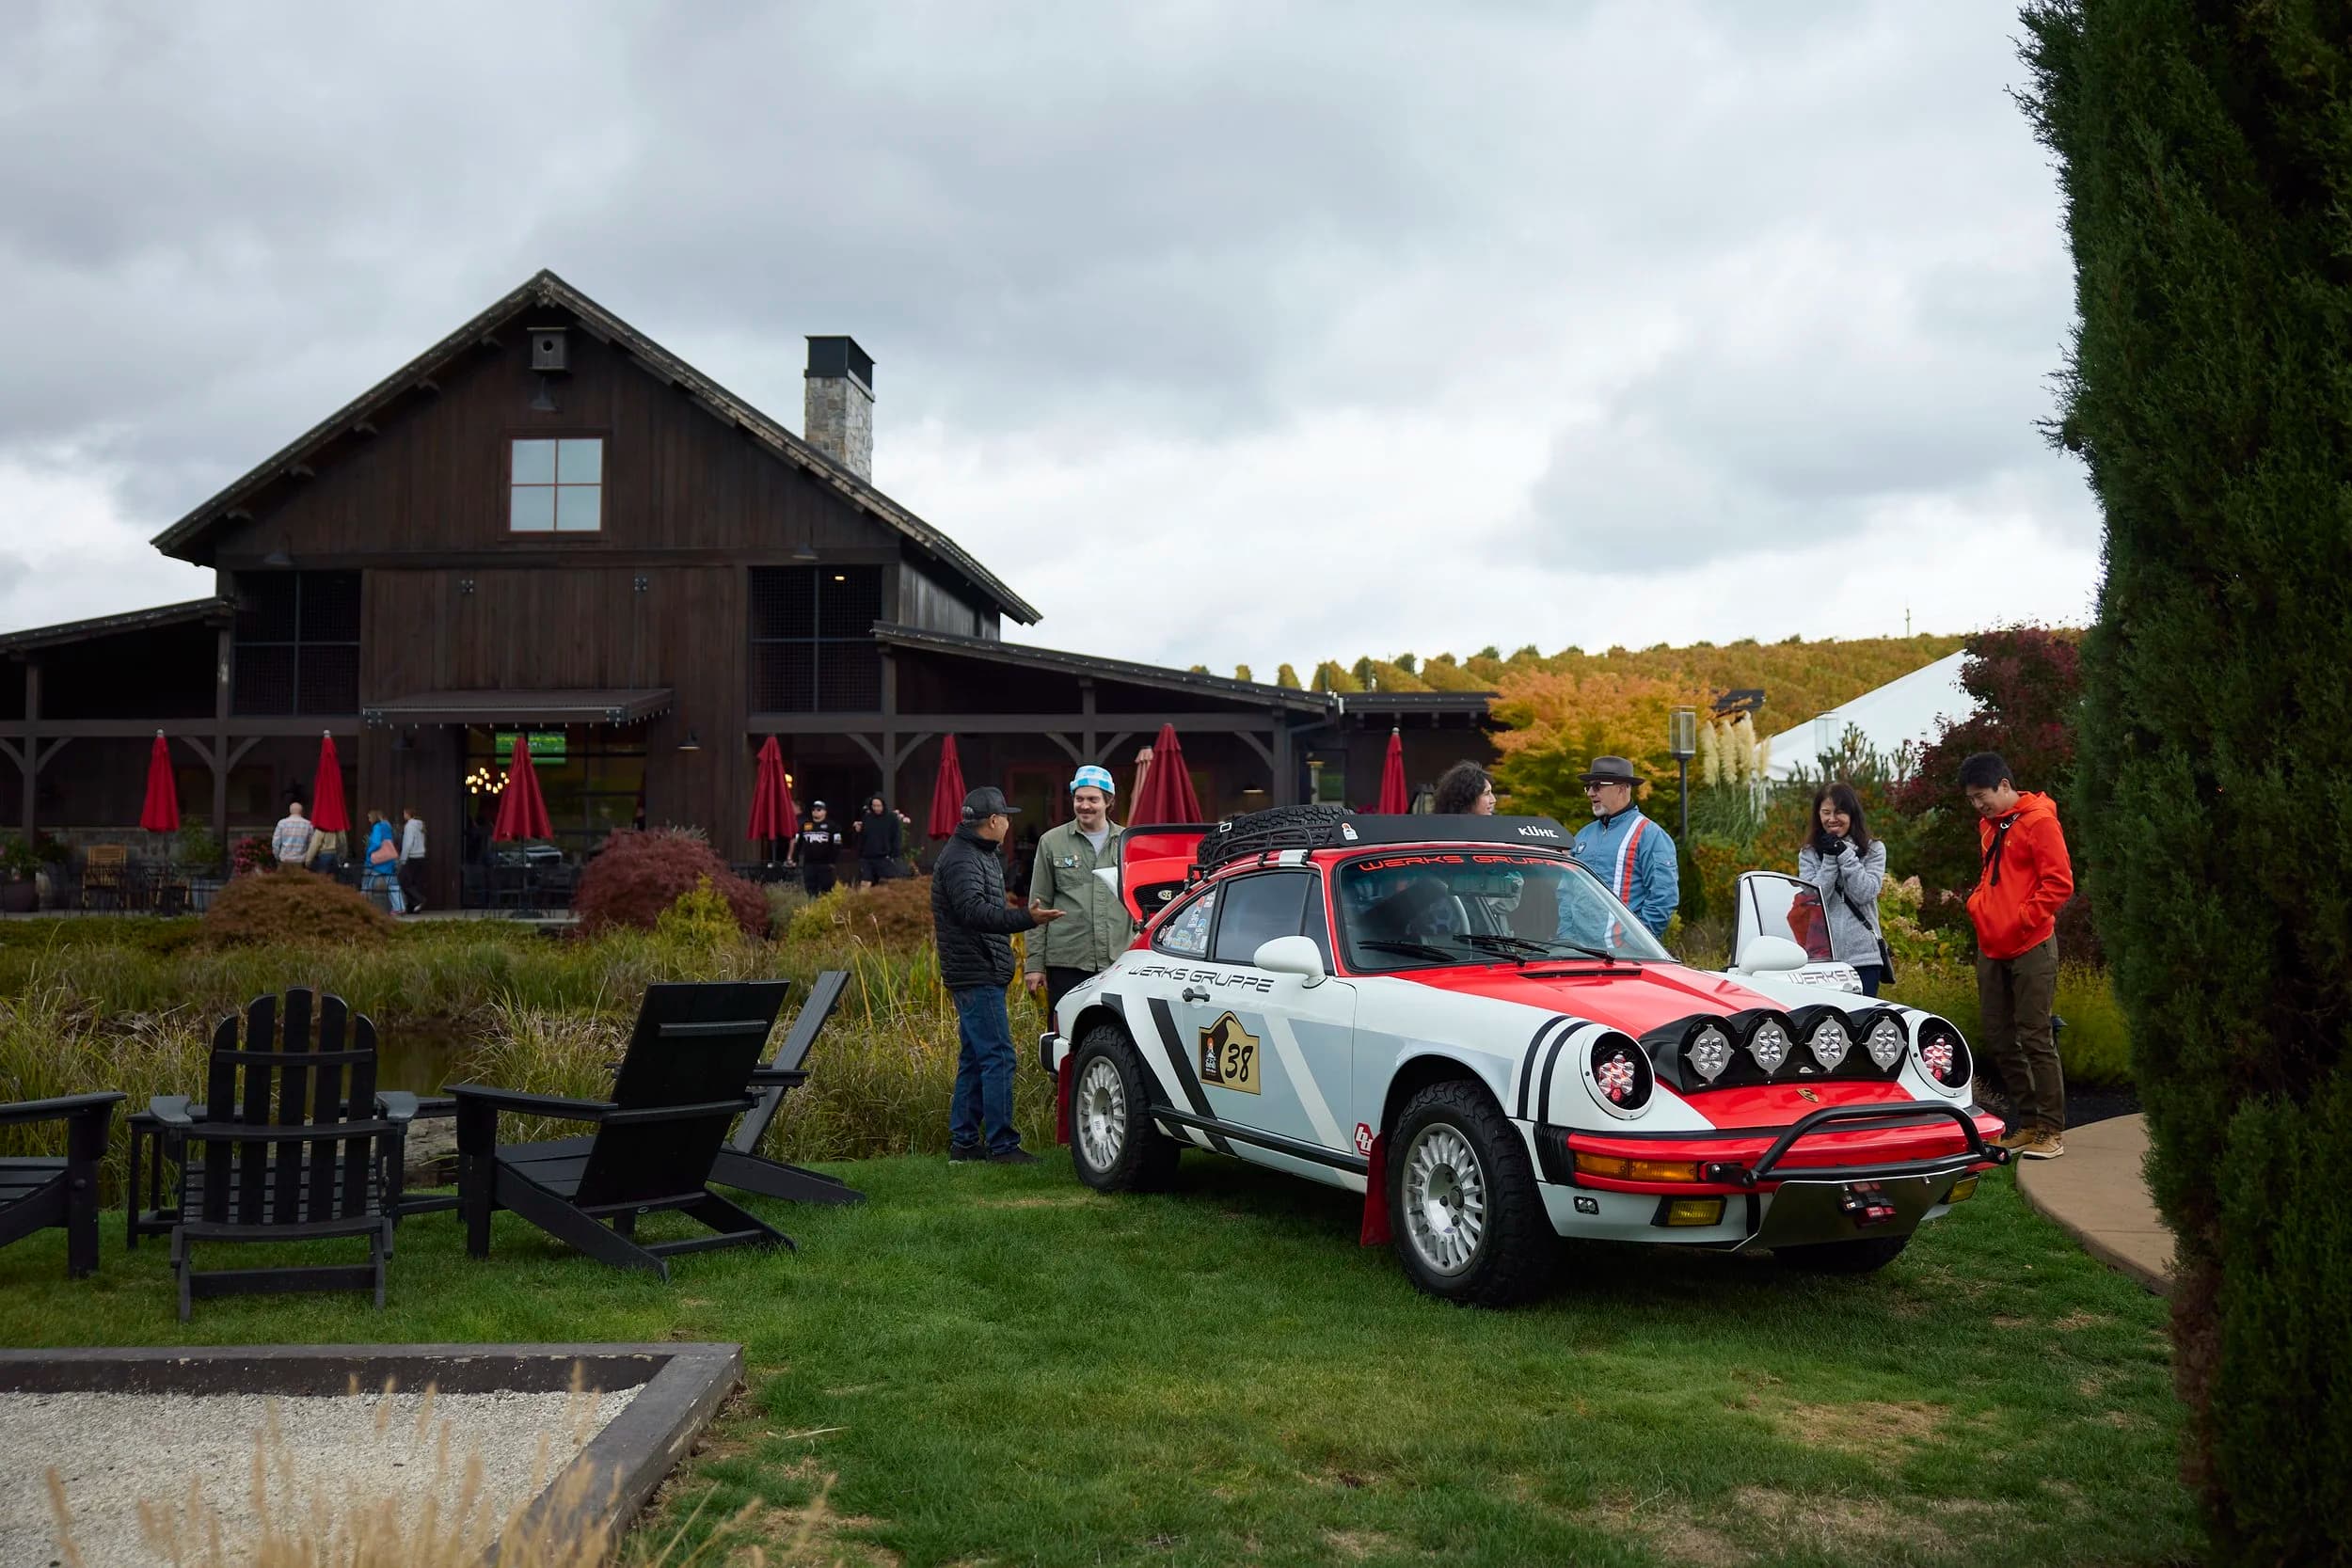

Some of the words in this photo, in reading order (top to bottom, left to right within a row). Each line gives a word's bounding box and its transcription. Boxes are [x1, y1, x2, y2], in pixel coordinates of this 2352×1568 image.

[1359, 855, 1464, 872] WERKS
[1128, 966, 1189, 980] WERKS
[1189, 970, 1275, 993] GRUPPE
[1787, 970, 1849, 985] WERKS
[1225, 1043, 1253, 1082] 38
